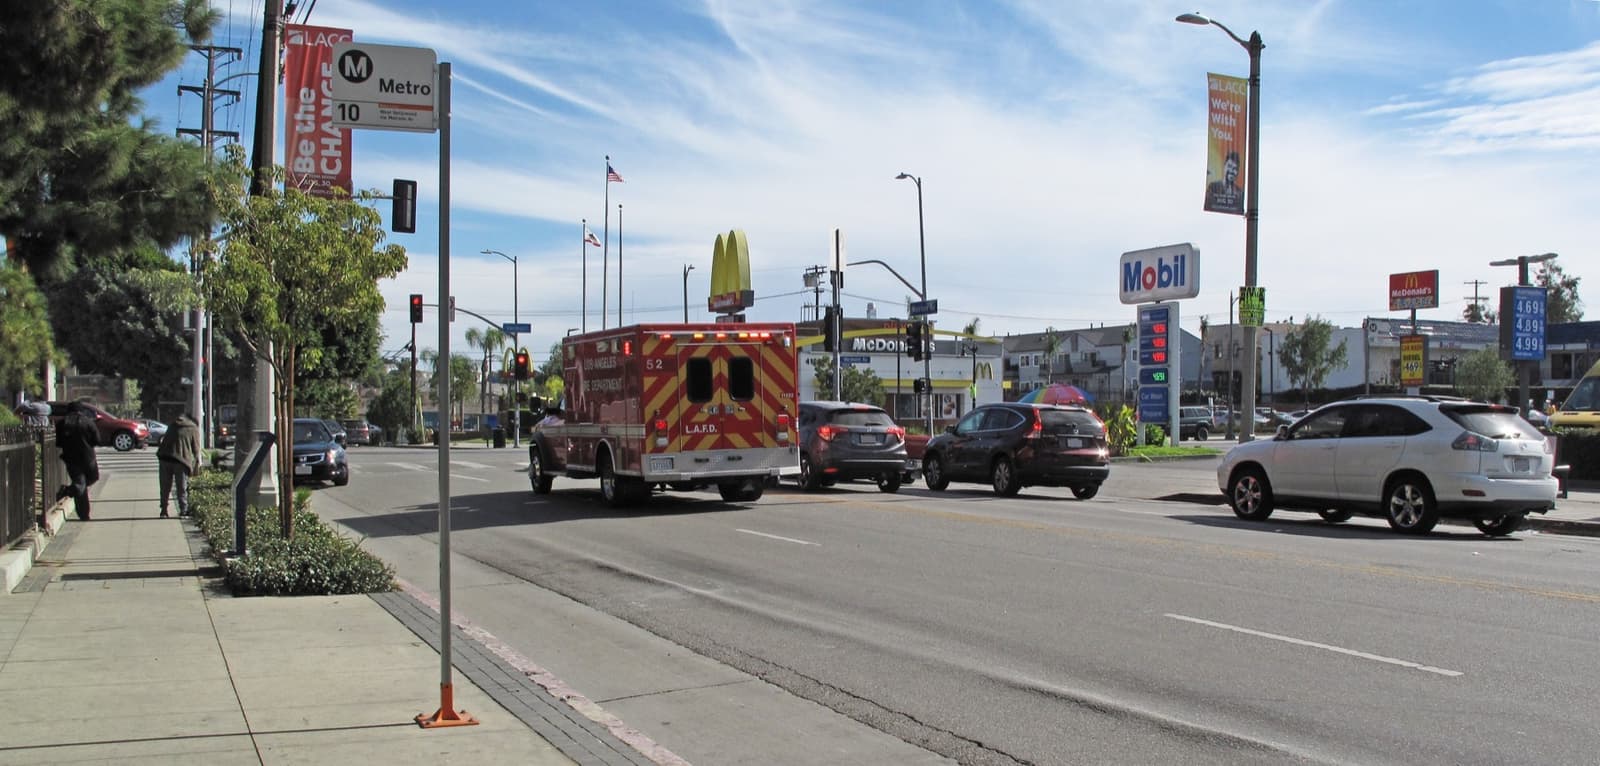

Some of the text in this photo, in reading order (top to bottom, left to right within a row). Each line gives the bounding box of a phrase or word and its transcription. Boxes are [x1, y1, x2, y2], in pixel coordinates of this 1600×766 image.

[379, 78, 431, 96] Metro
[294, 87, 316, 133] the
[337, 103, 360, 122] 10
[1211, 98, 1241, 113] We're
[1211, 113, 1237, 127] With
[294, 138, 316, 174] Be
[1124, 254, 1186, 292] Mobil
[1392, 287, 1432, 297] McDonald's
[1516, 300, 1539, 314] 4.69
[1516, 318, 1539, 333] 4.89
[1515, 337, 1538, 351] 4.99
[685, 424, 718, 434] L.A.F.D.
